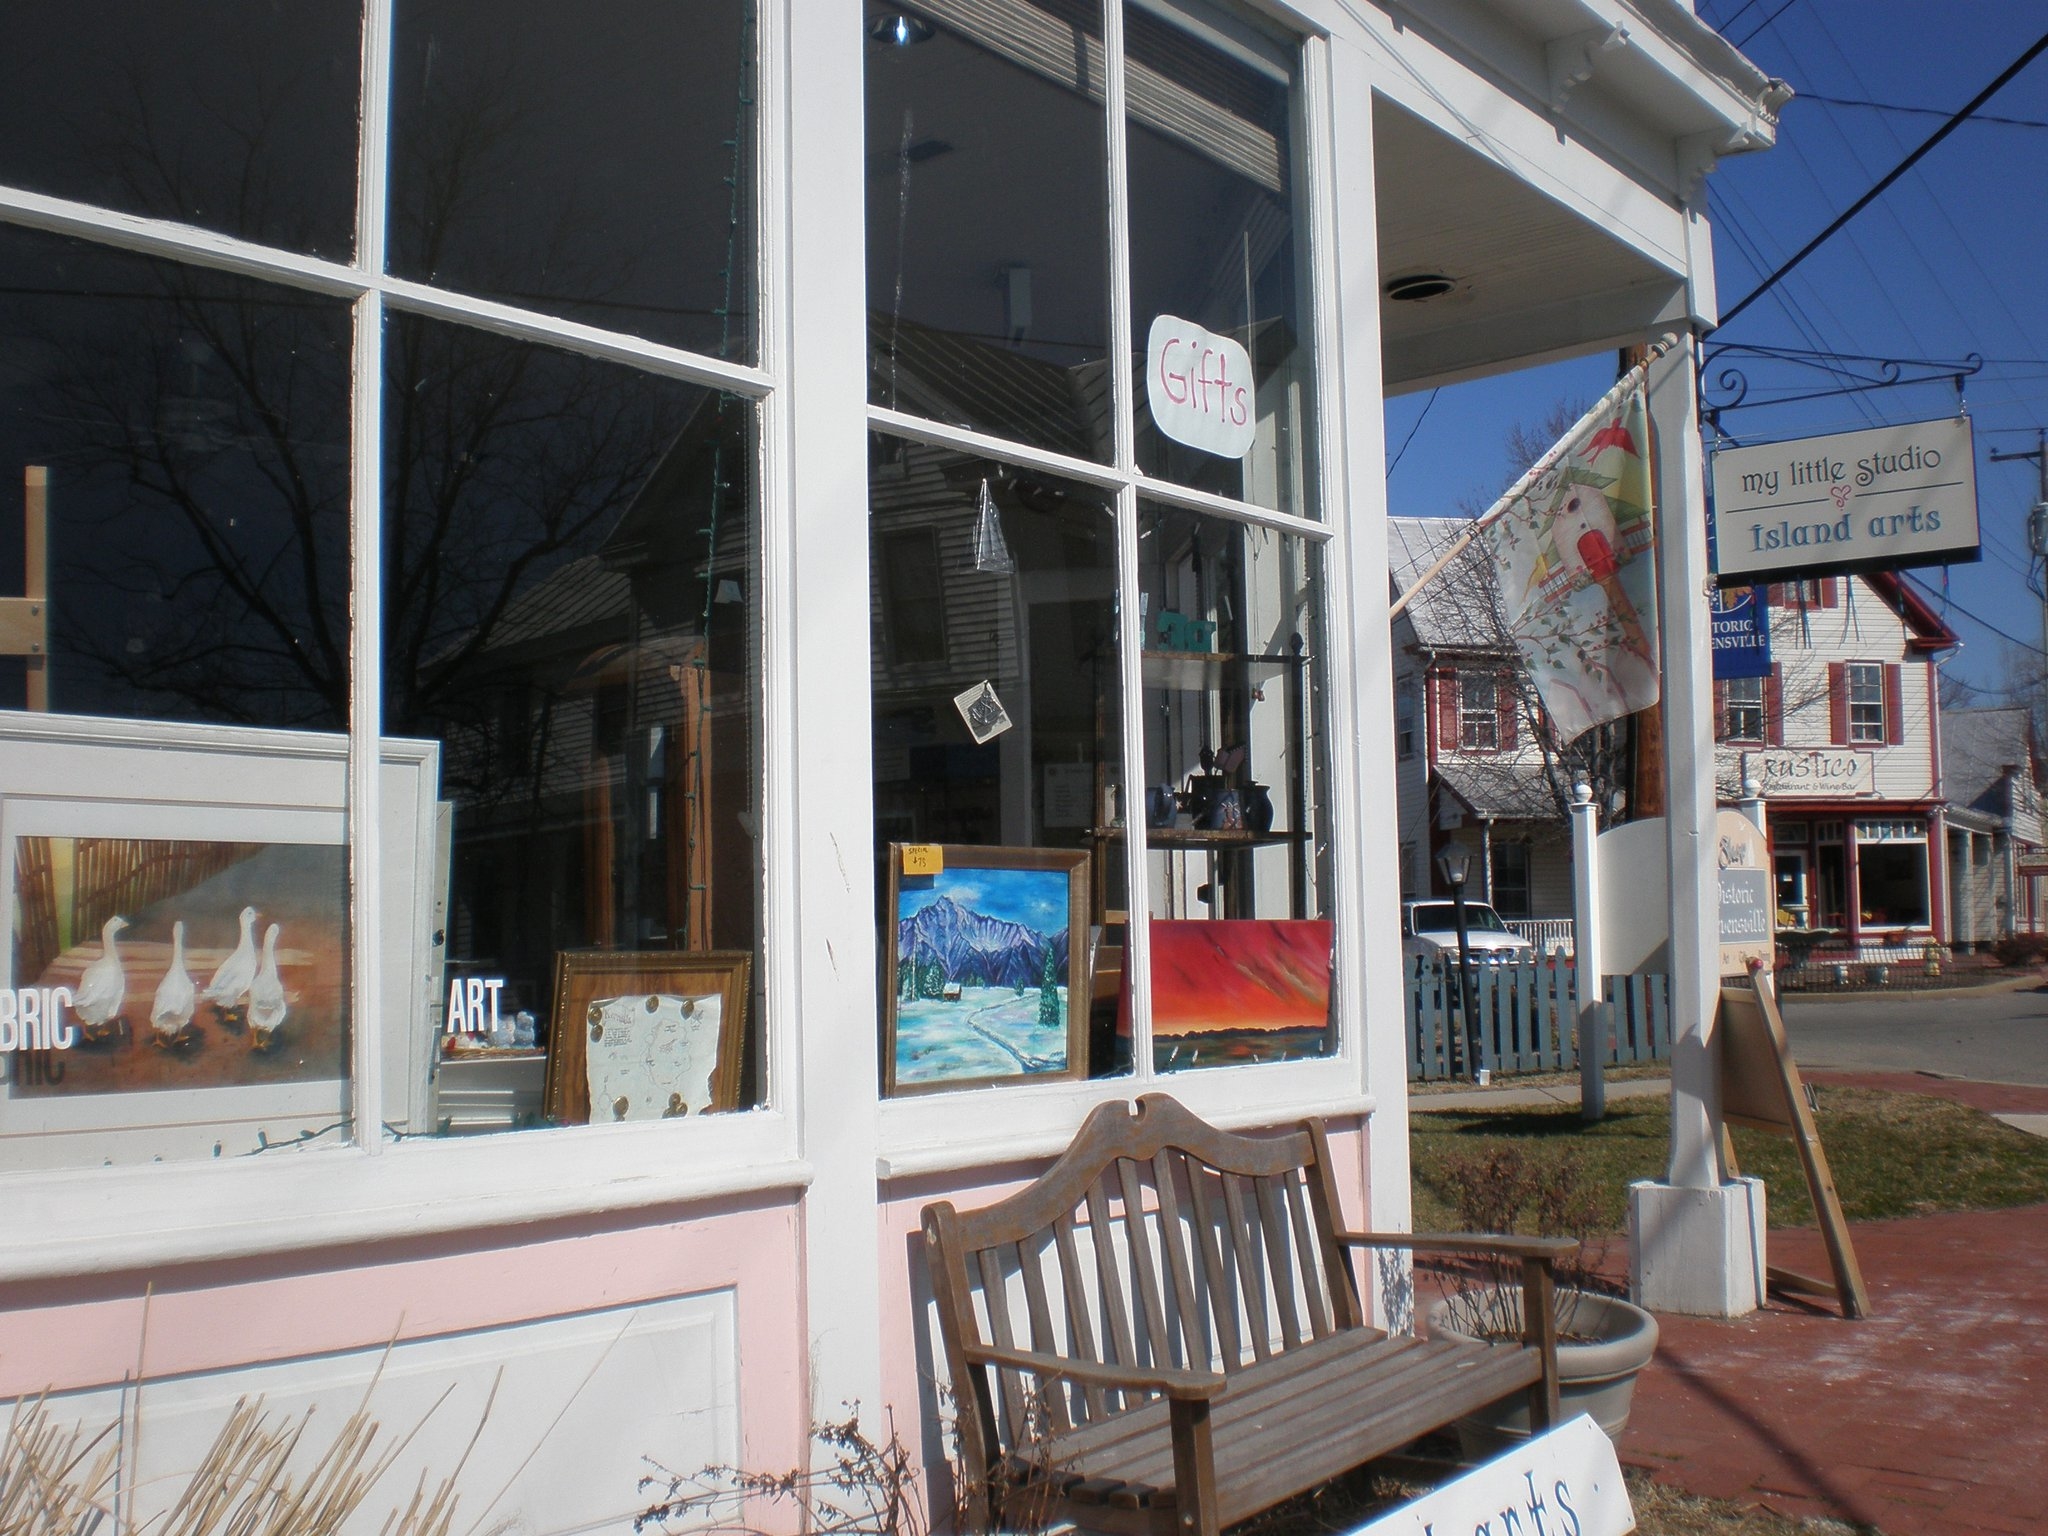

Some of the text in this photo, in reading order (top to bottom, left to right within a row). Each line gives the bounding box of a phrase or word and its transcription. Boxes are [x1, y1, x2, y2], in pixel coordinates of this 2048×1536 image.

[1160, 338, 1247, 426] Gifts
[1742, 470, 1779, 496] my
[1789, 456, 1847, 486] little
[1868, 505, 1942, 538] arts
[1820, 782, 1841, 791] Wine
[1843, 782, 1858, 791] Bar
[0, 986, 73, 1052] BRIC
[447, 978, 504, 1033] ART
